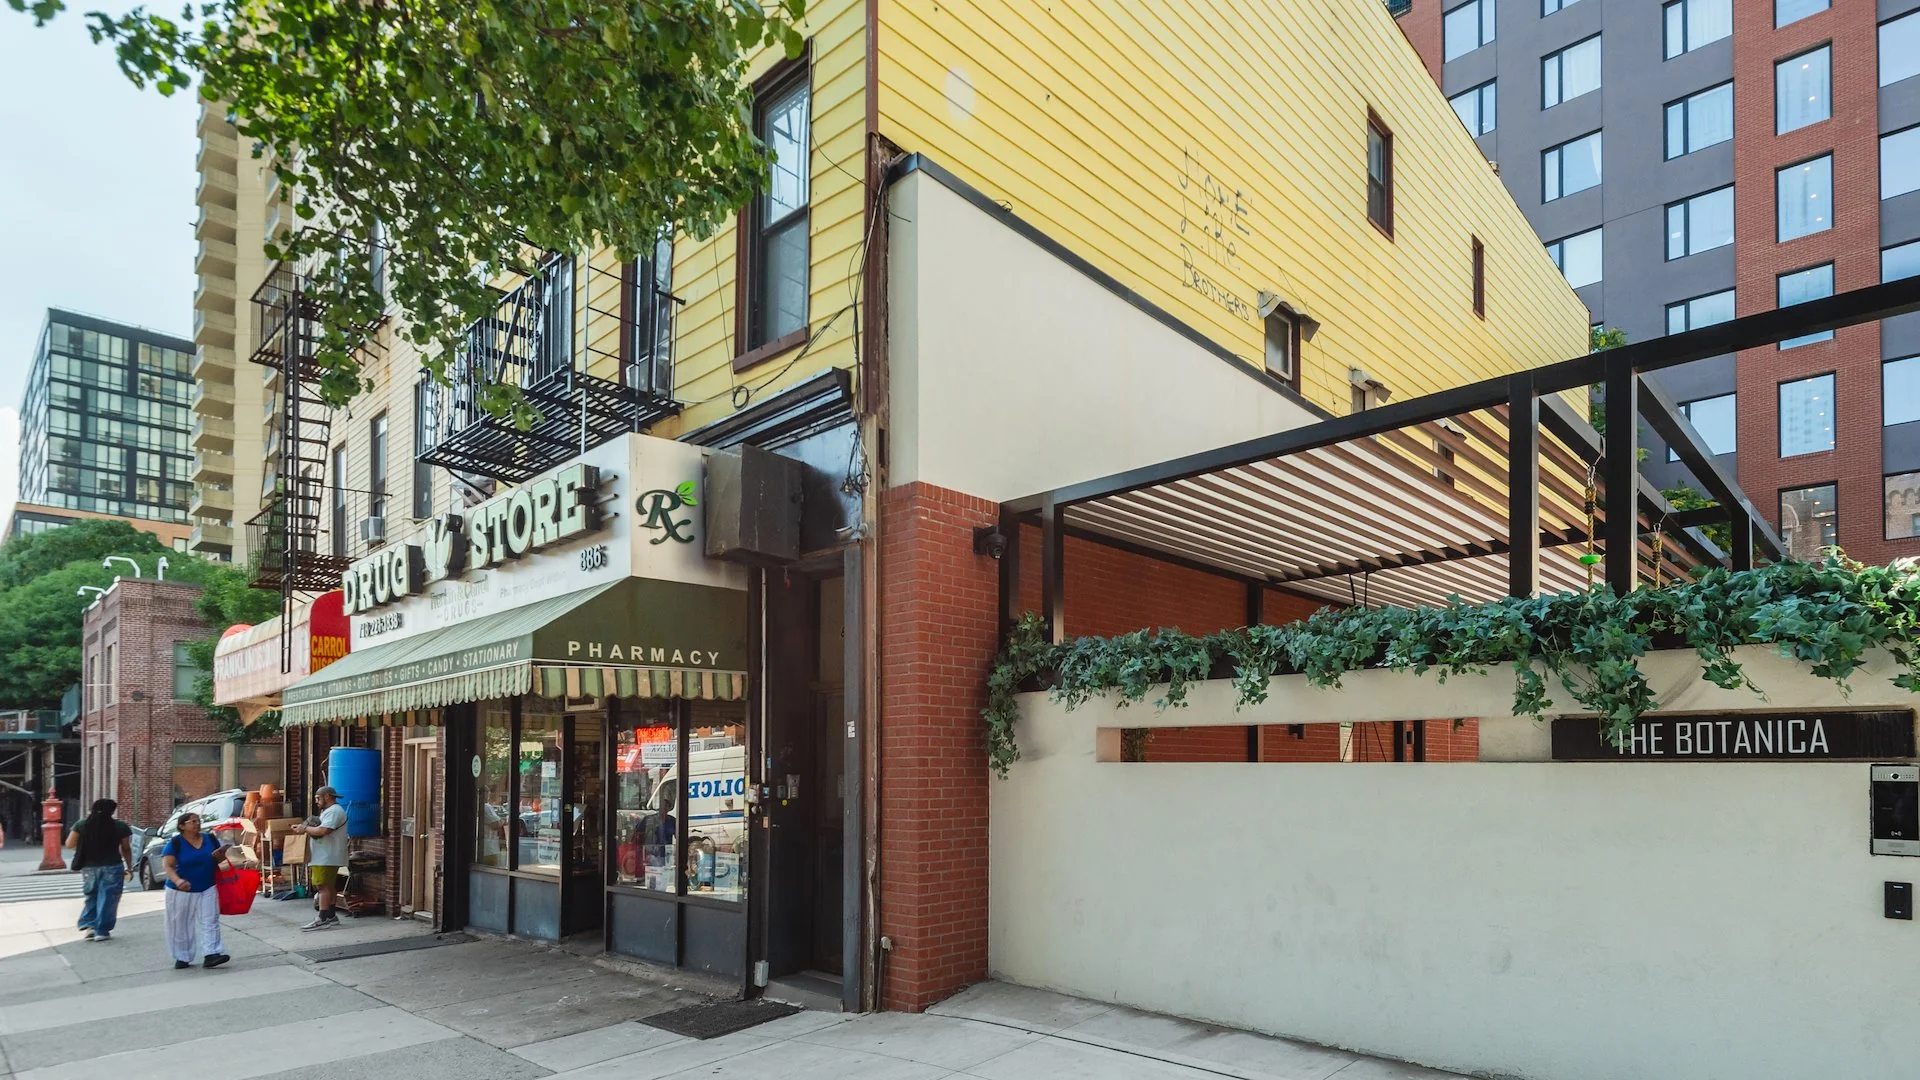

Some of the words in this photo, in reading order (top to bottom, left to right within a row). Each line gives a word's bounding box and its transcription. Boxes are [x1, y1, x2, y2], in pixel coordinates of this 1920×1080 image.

[342, 544, 410, 616] DRUG
[471, 463, 587, 569] STORE
[580, 543, 602, 571] 886
[311, 635, 348, 657] CARROL
[568, 640, 719, 666] PHARMACY
[358, 674, 369, 690] OTC
[372, 670, 393, 689] DRUGS
[401, 663, 420, 681] GIFTS
[428, 657, 453, 675] CANDY
[463, 641, 519, 666] STATIONARY
[1676, 718, 1829, 755] BOTANICA
